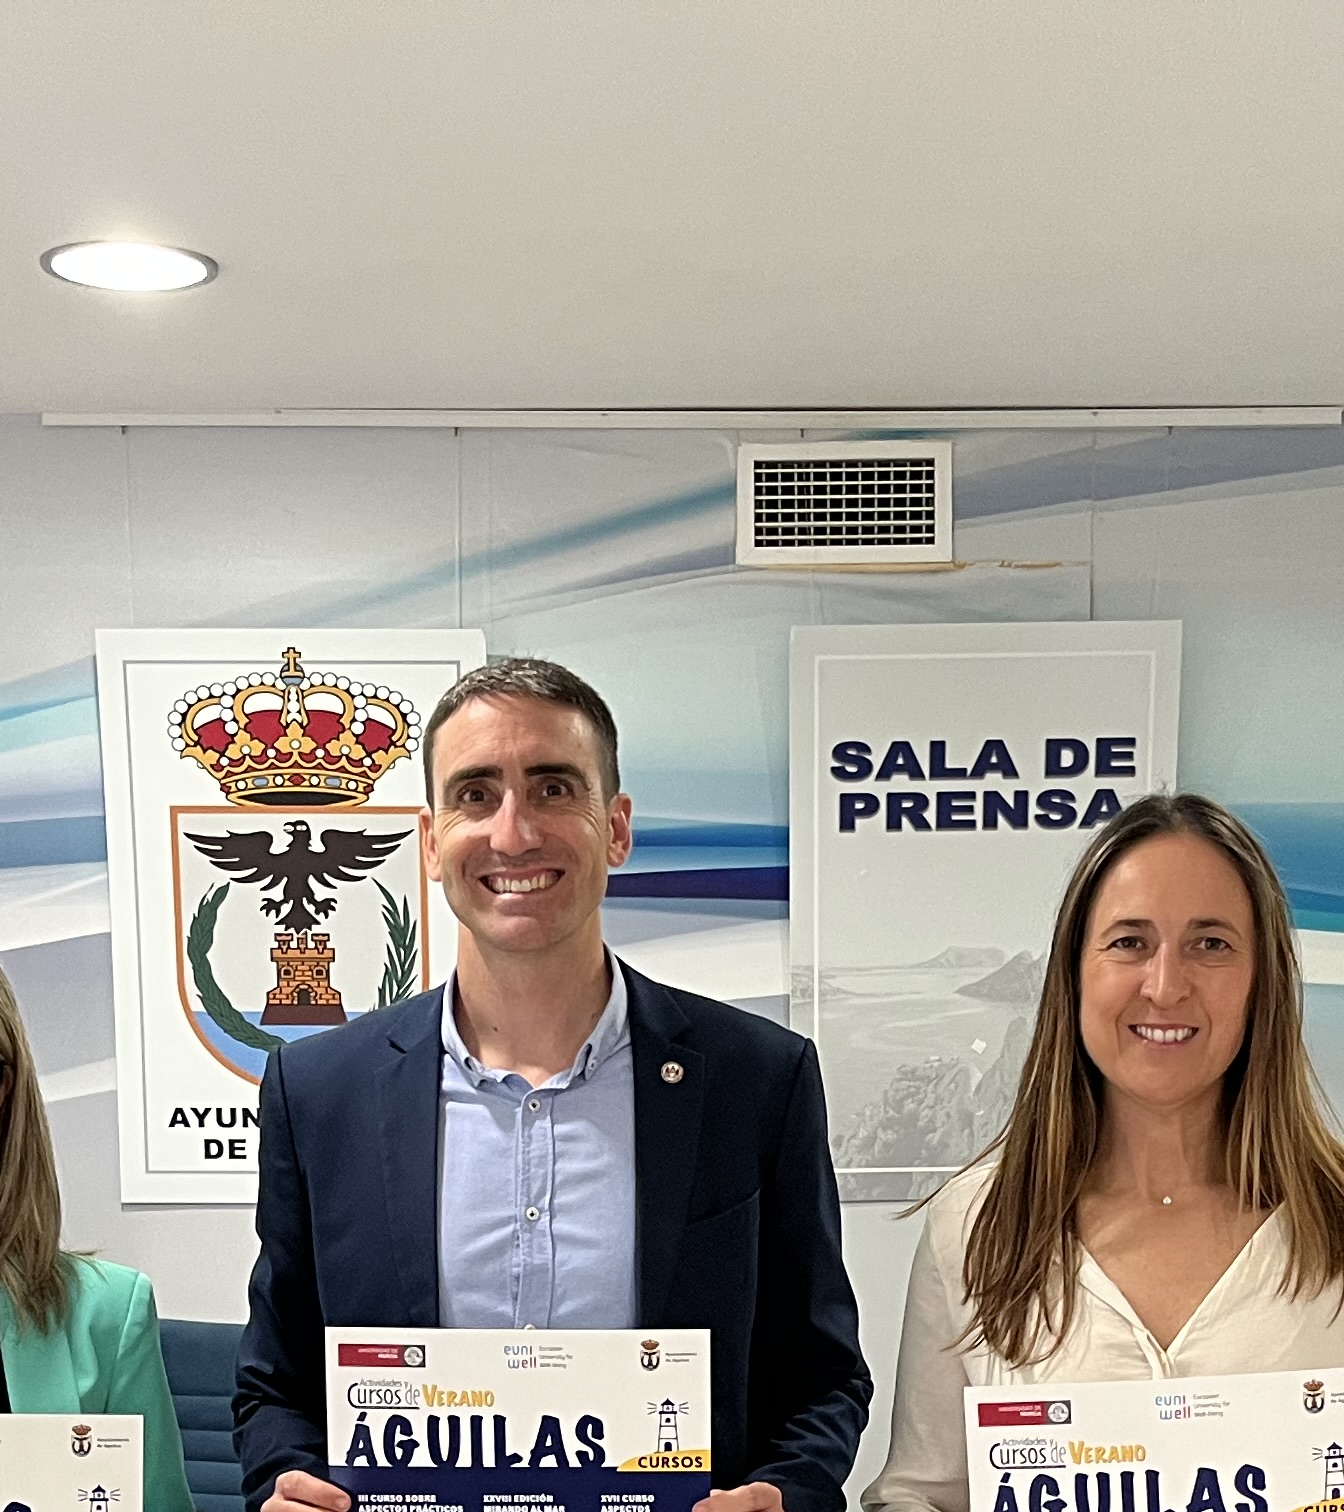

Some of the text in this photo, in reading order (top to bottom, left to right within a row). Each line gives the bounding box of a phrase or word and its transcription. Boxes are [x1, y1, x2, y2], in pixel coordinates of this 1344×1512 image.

[830, 737, 1137, 782] SALA DE
[838, 788, 1124, 833] PRENSA
[168, 1107, 261, 1129] AYUN
[203, 1138, 248, 1160] DE
[508, 1357, 537, 1368] well
[1158, 1406, 1190, 1419] well
[345, 1411, 605, 1466] ÁGUILAS
[638, 1456, 702, 1468] CURSOS
